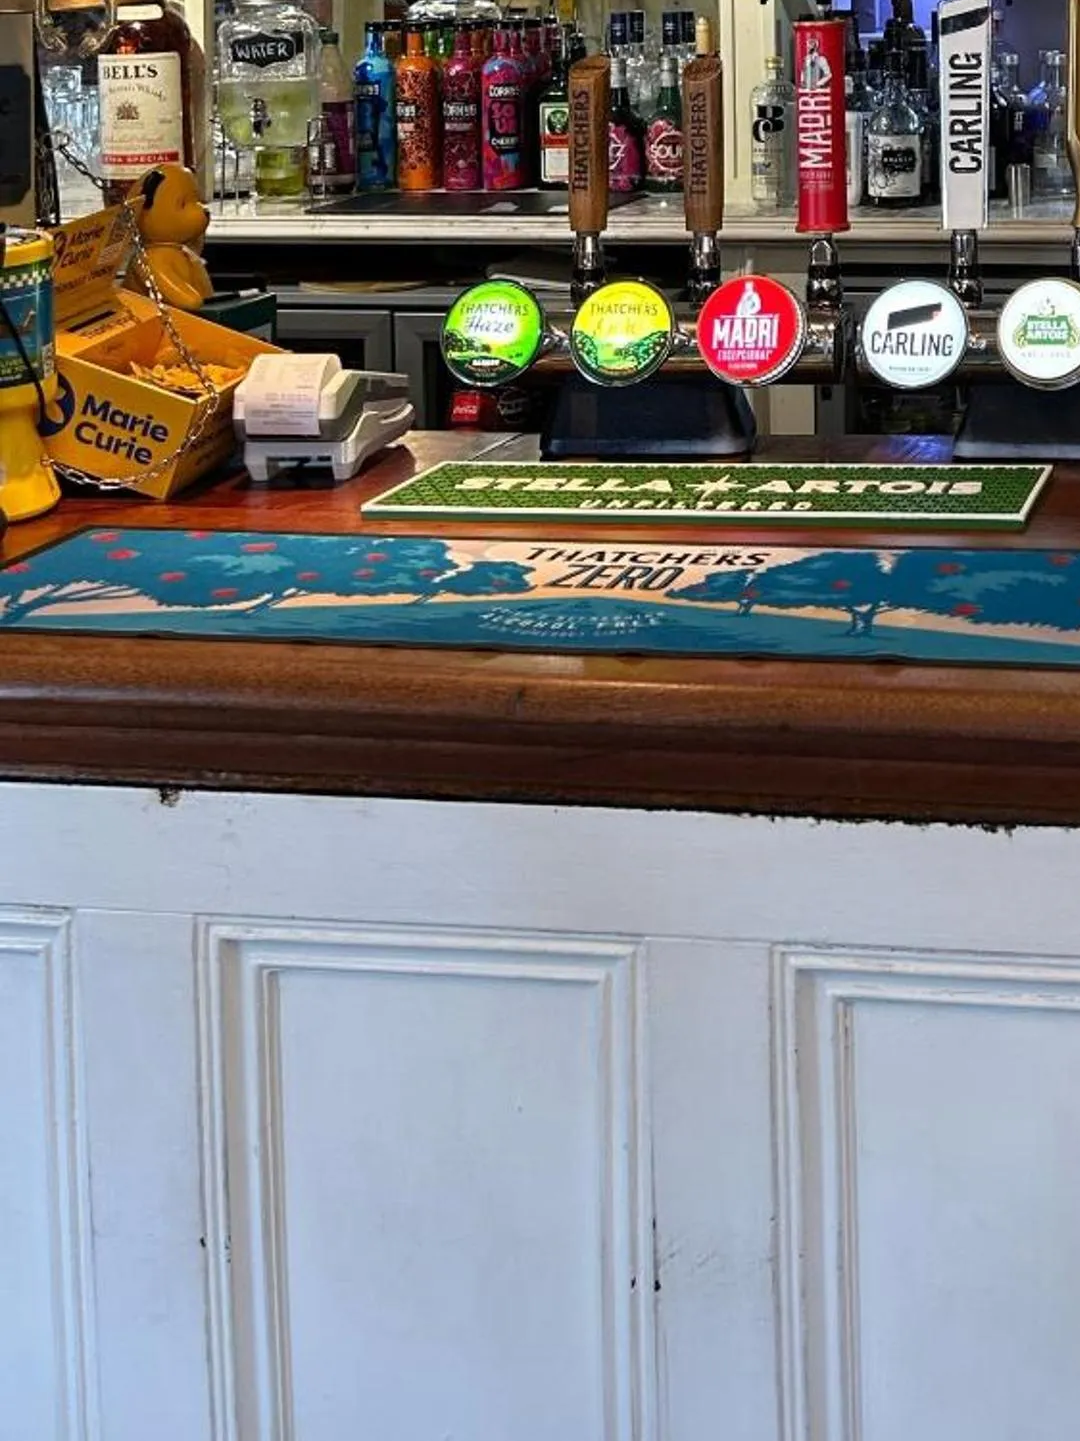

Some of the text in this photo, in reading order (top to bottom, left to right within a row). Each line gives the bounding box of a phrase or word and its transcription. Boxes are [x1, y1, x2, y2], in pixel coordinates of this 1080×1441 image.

[234, 42, 288, 60] WATER
[103, 63, 158, 80] BELL'S
[949, 51, 983, 175] CARLING
[572, 89, 590, 193] THATCHERS
[689, 91, 708, 196] THATCHERS
[460, 302, 529, 317] THATCHERS
[590, 302, 659, 317] THATCHERS
[465, 314, 514, 334] Haze
[1026, 319, 1070, 331] STELLA
[871, 329, 954, 358] CARLING
[1026, 329, 1070, 341] ARTOIS
[81, 393, 169, 443] Marie
[75, 421, 153, 465] Curie
[454, 476, 983, 496] STELLA ARTOIS
[577, 498, 815, 511] UNFILTERED
[526, 546, 771, 567] THATCHERS
[542, 563, 685, 592] ZERO
